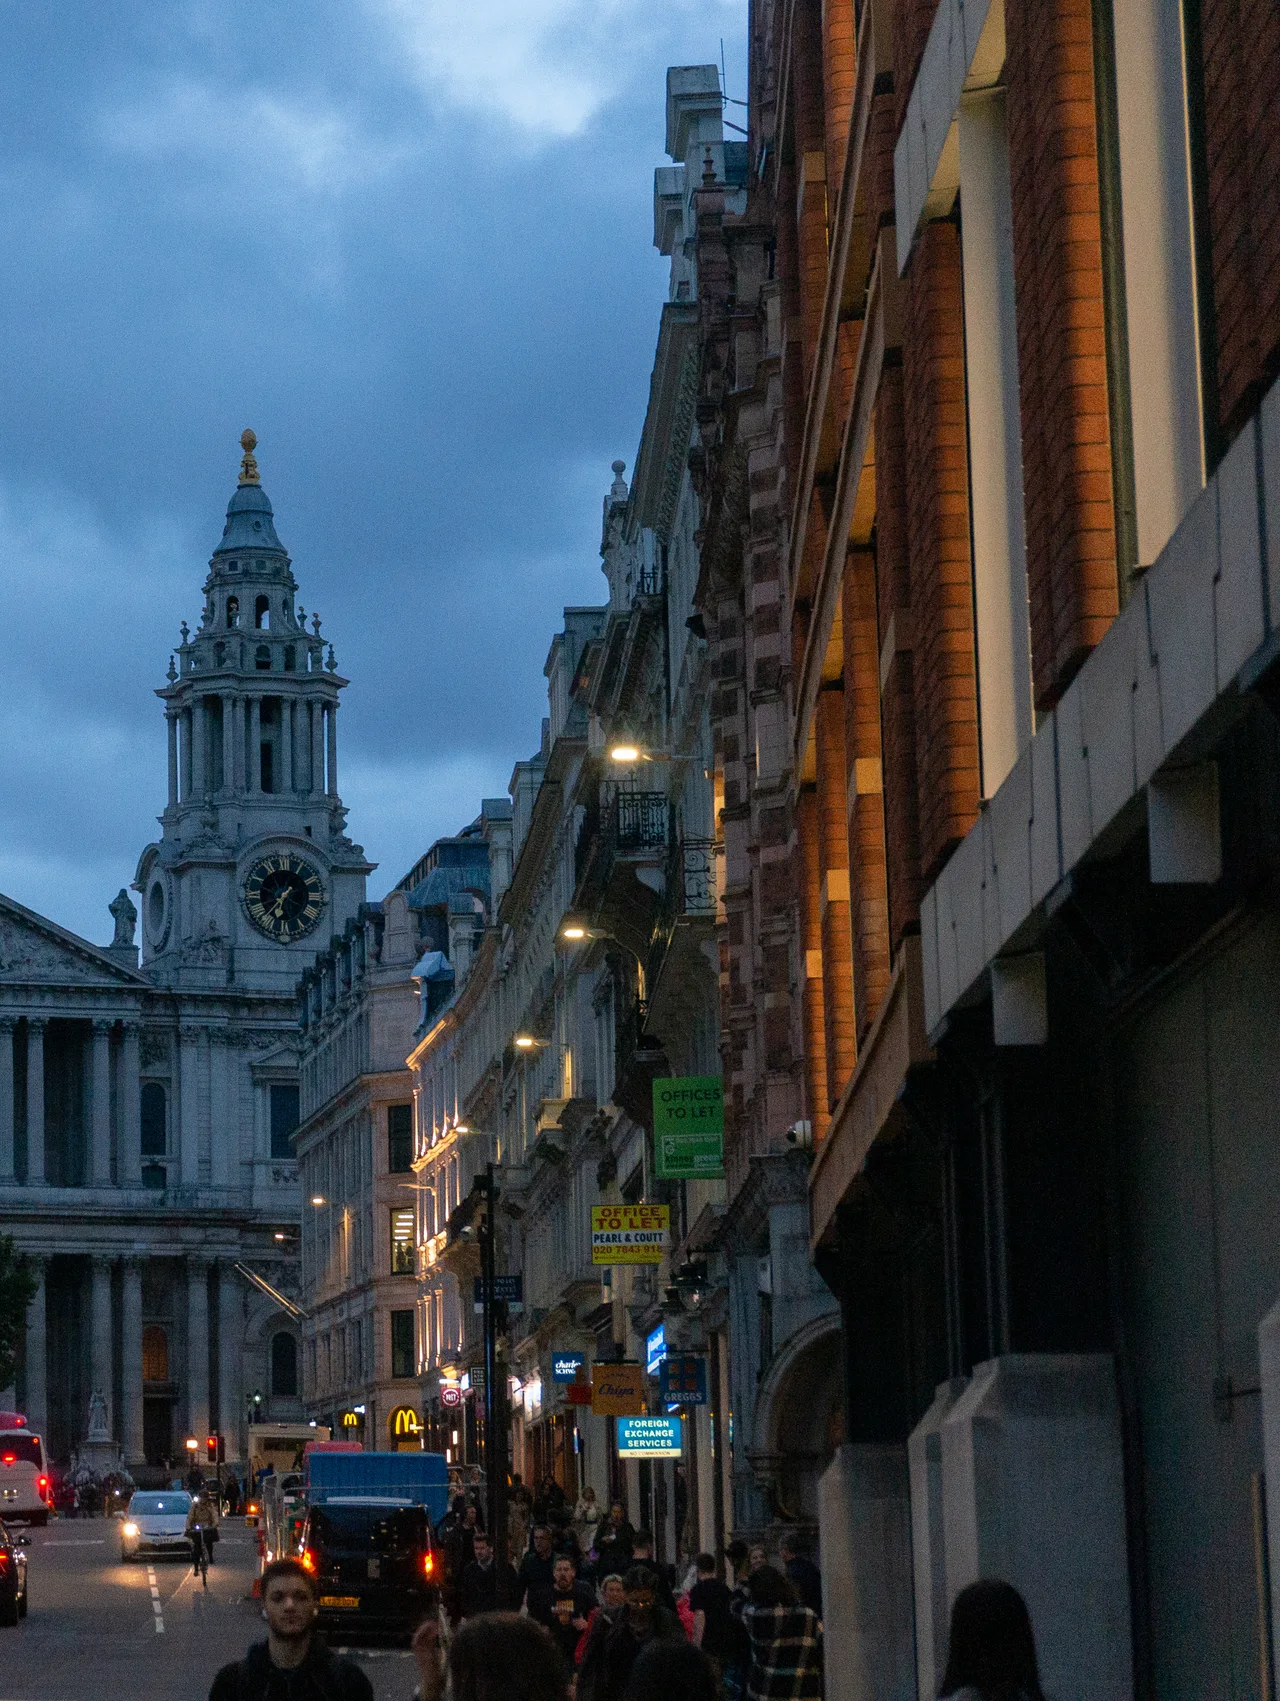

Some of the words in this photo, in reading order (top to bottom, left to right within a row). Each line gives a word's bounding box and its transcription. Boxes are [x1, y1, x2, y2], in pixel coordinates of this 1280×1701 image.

[661, 1089, 721, 1103] OFFICES
[666, 1107, 686, 1119] TO
[691, 1105, 715, 1118] LET
[601, 1207, 660, 1218] OFFICE
[595, 1219, 622, 1230] TO
[629, 1217, 666, 1229] LET
[593, 1234, 622, 1243] PEARL
[625, 1234, 632, 1243] &
[634, 1233, 663, 1243] COUTT
[593, 1246, 613, 1254] 020
[664, 1393, 702, 1402] GREGGS
[629, 1420, 669, 1428] FOREIGN
[624, 1430, 674, 1438] EXCHANGE
